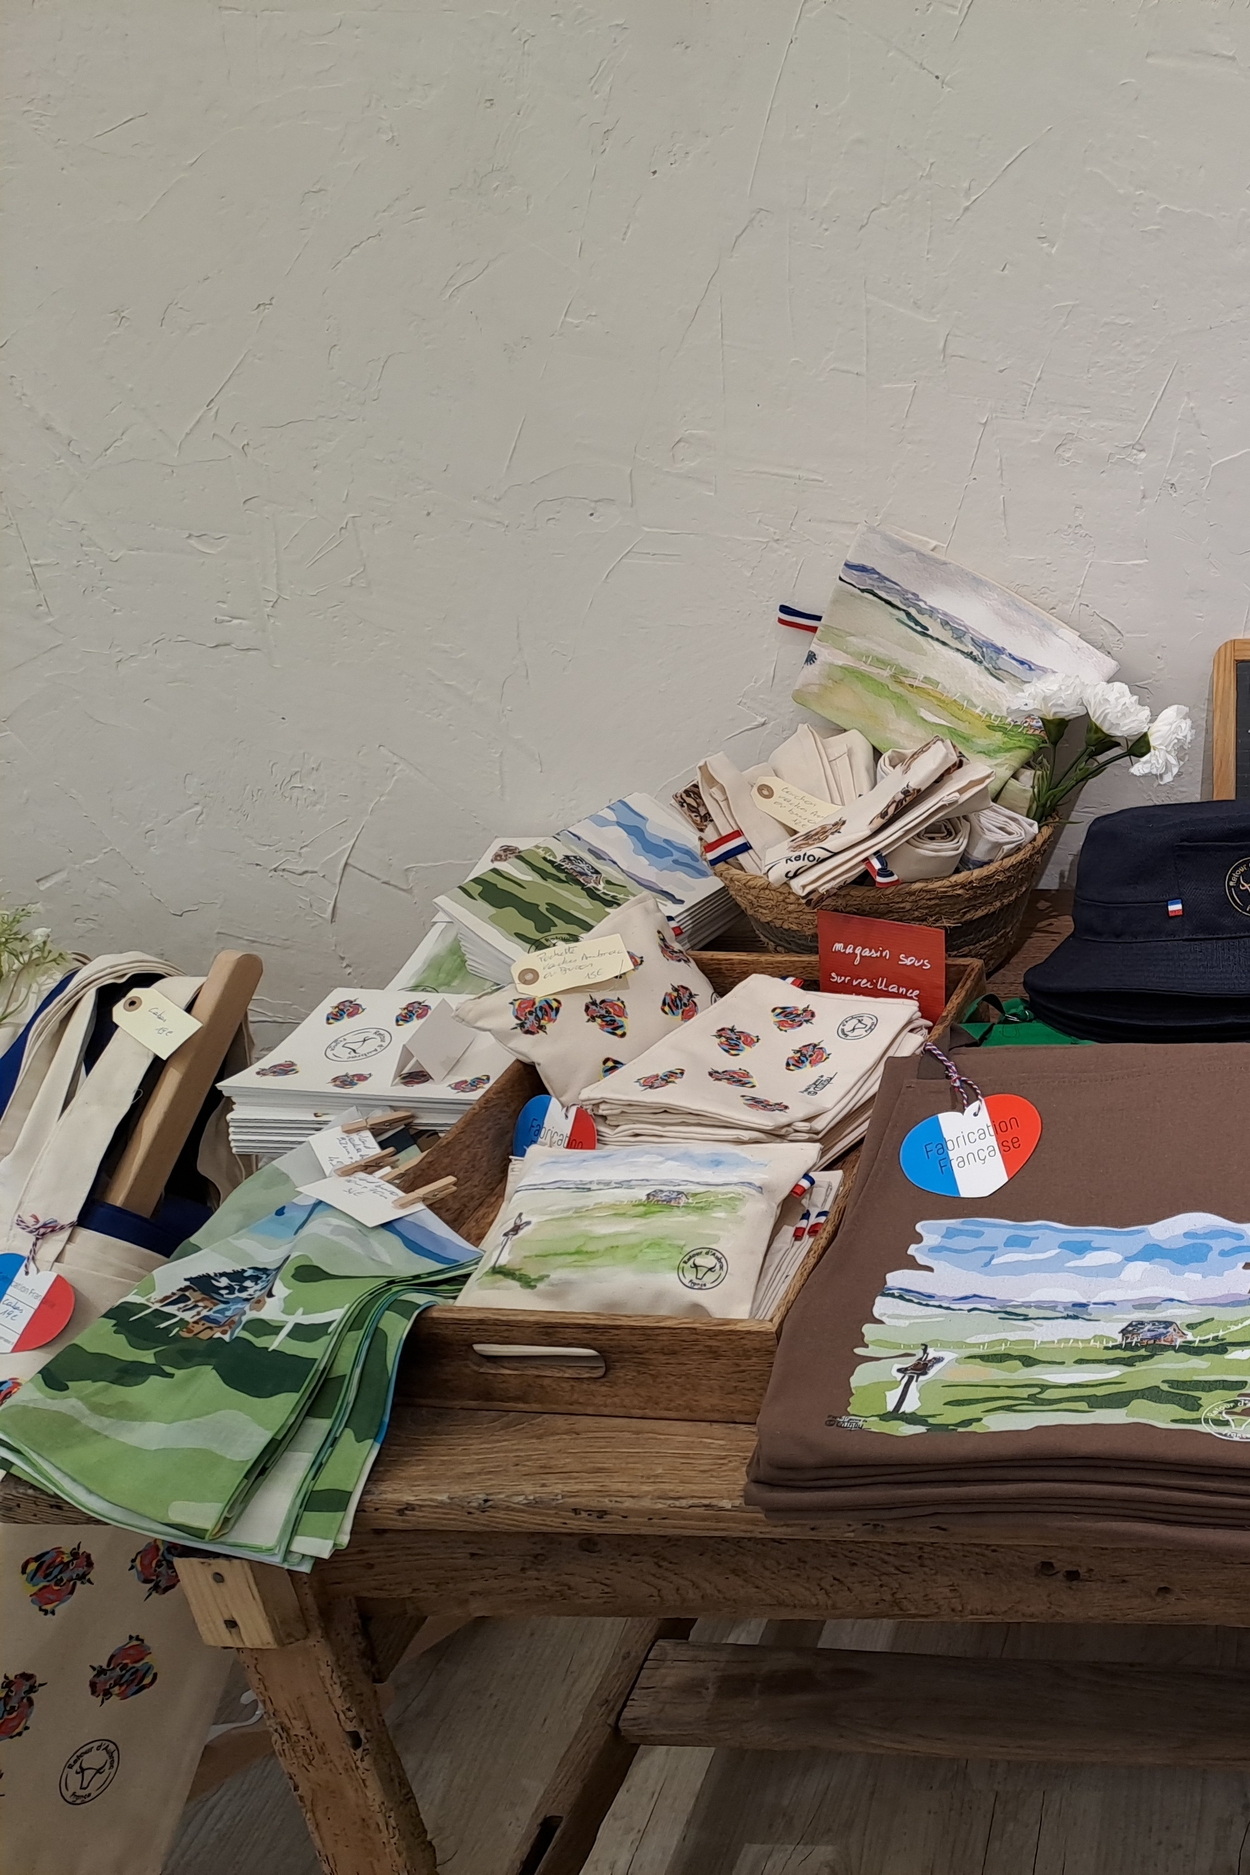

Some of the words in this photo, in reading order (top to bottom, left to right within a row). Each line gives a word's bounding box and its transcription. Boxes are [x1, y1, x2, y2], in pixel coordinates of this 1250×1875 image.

[1229, 864, 1247, 886] Retour
[832, 942, 890, 965] magasin
[898, 953, 931, 970] sous
[830, 972, 920, 999] surveillance
[923, 1116, 1021, 1160] Fabrication
[938, 1135, 1021, 1175] Françase
